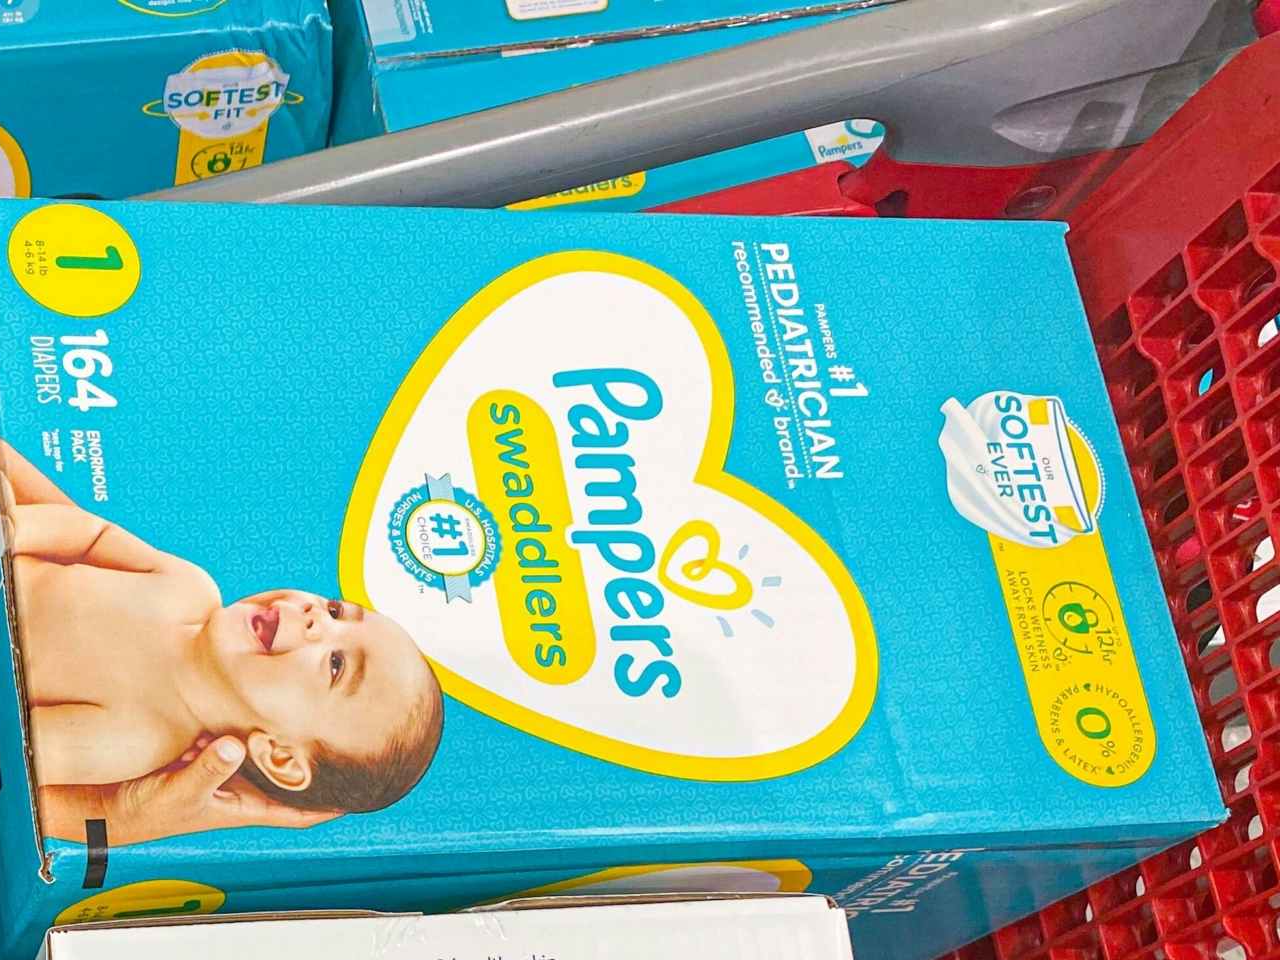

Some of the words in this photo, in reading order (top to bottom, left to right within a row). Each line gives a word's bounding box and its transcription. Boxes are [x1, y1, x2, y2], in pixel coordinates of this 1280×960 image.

[167, 80, 287, 110] SOFTEST
[213, 106, 245, 120] FIT
[818, 141, 863, 158] Pampers
[55, 244, 125, 271] 1
[731, 240, 782, 384] recommended
[30, 335, 62, 406] DIAPERS
[59, 328, 119, 413] 164
[761, 243, 844, 479] PEDIATRICIAN
[814, 303, 837, 359] PAMPERS
[827, 364, 869, 397] #1
[70, 429, 87, 464] PACK
[86, 429, 109, 503] ENORMOUS
[985, 441, 1015, 499] EVER
[993, 394, 1058, 545] SOFTEST
[1040, 456, 1055, 482] OUR
[392, 492, 422, 528] NURSES
[417, 516, 433, 561] CHOICE
[429, 512, 469, 556] #1
[489, 402, 567, 668] swaddlers
[552, 367, 682, 699] Pampers
[474, 519, 496, 577] HOSPITALS
[1006, 569, 1020, 602] AWAY
[1015, 606, 1030, 642] FROM
[1025, 643, 1040, 673] SKIN
[1019, 571, 1034, 610] LOCKS
[1030, 616, 1052, 670] WETNESS
[1095, 629, 1117, 665] 12hr
[1050, 684, 1080, 735] PARABENS
[1095, 684, 1144, 775] HYPOALLERGENIC
